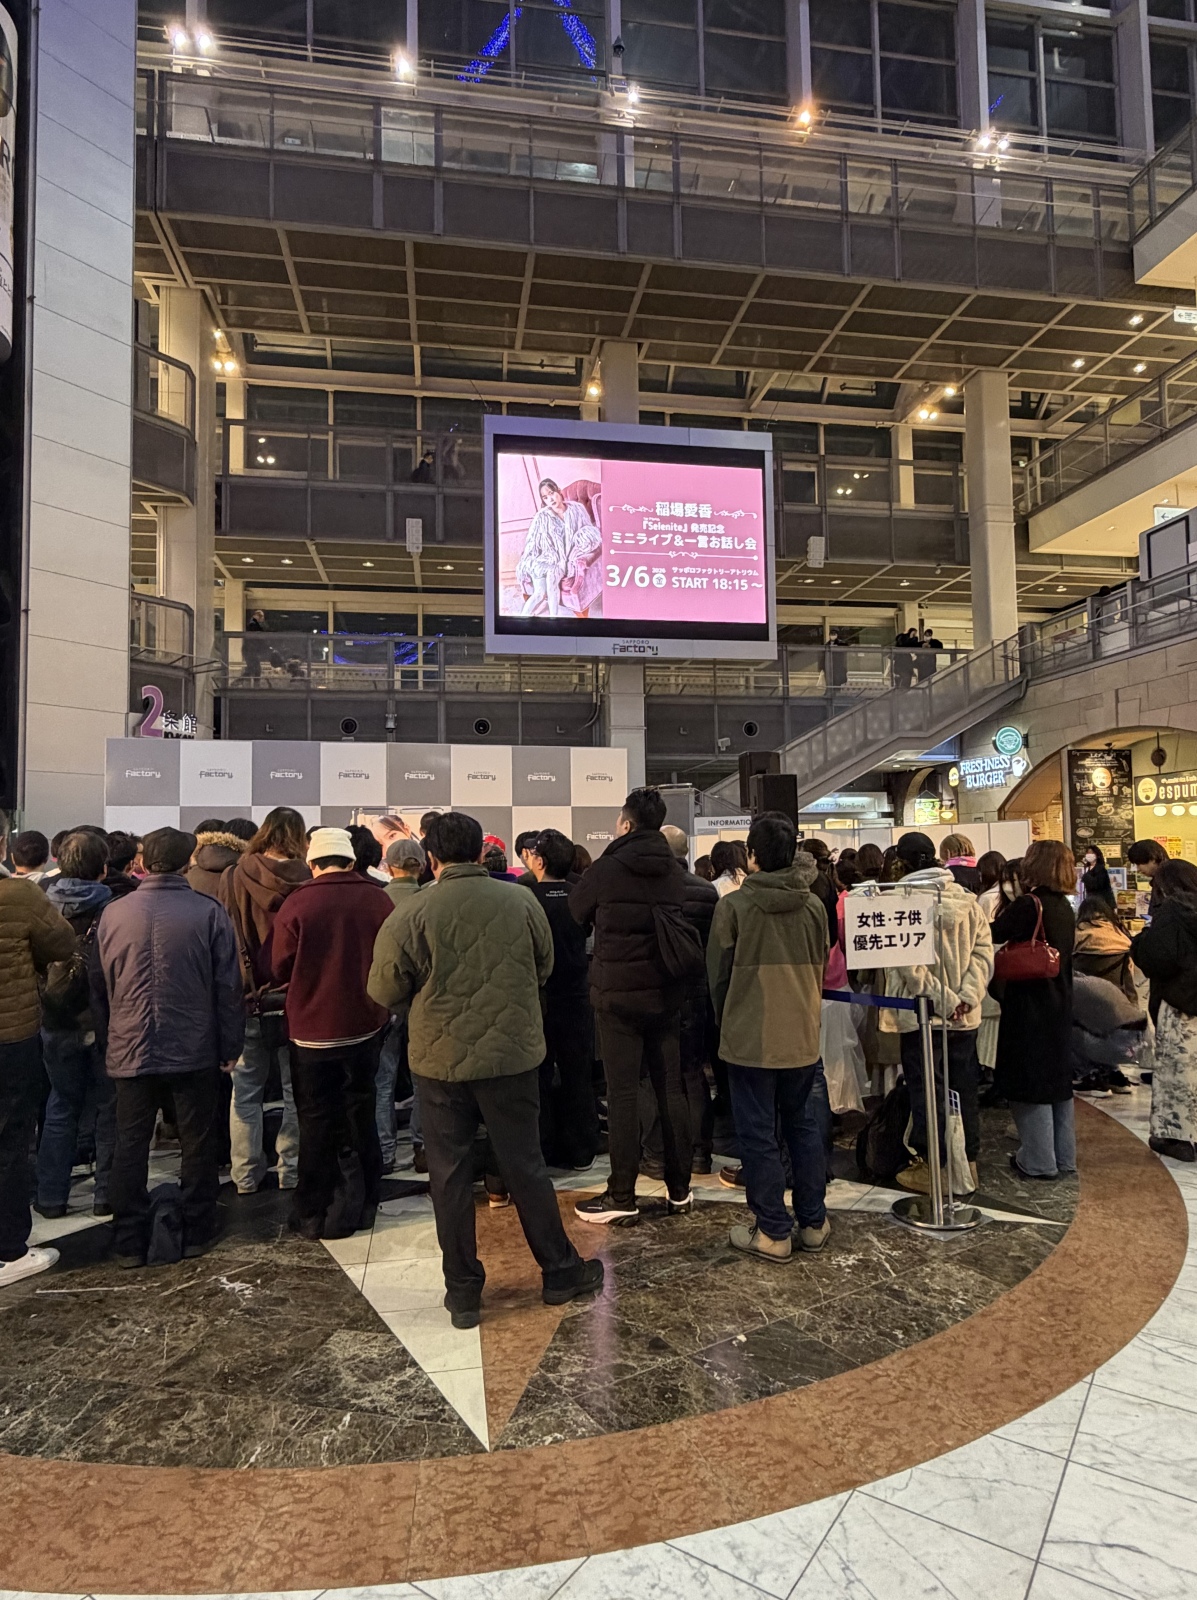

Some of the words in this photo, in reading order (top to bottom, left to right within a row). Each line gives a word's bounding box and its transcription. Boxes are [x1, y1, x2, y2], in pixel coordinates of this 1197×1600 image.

[655, 501, 713, 518] 稲場愛香
[605, 564, 650, 588] 3/6
[671, 566, 760, 577] サッポロファクトリーアトリウム
[671, 576, 709, 589] START
[141, 684, 164, 738] 2
[960, 755, 1012, 775] FRESHNESS
[966, 770, 1006, 789] BURGER
[856, 909, 923, 929] 女性・子供
[853, 932, 927, 952] 優先エリア
